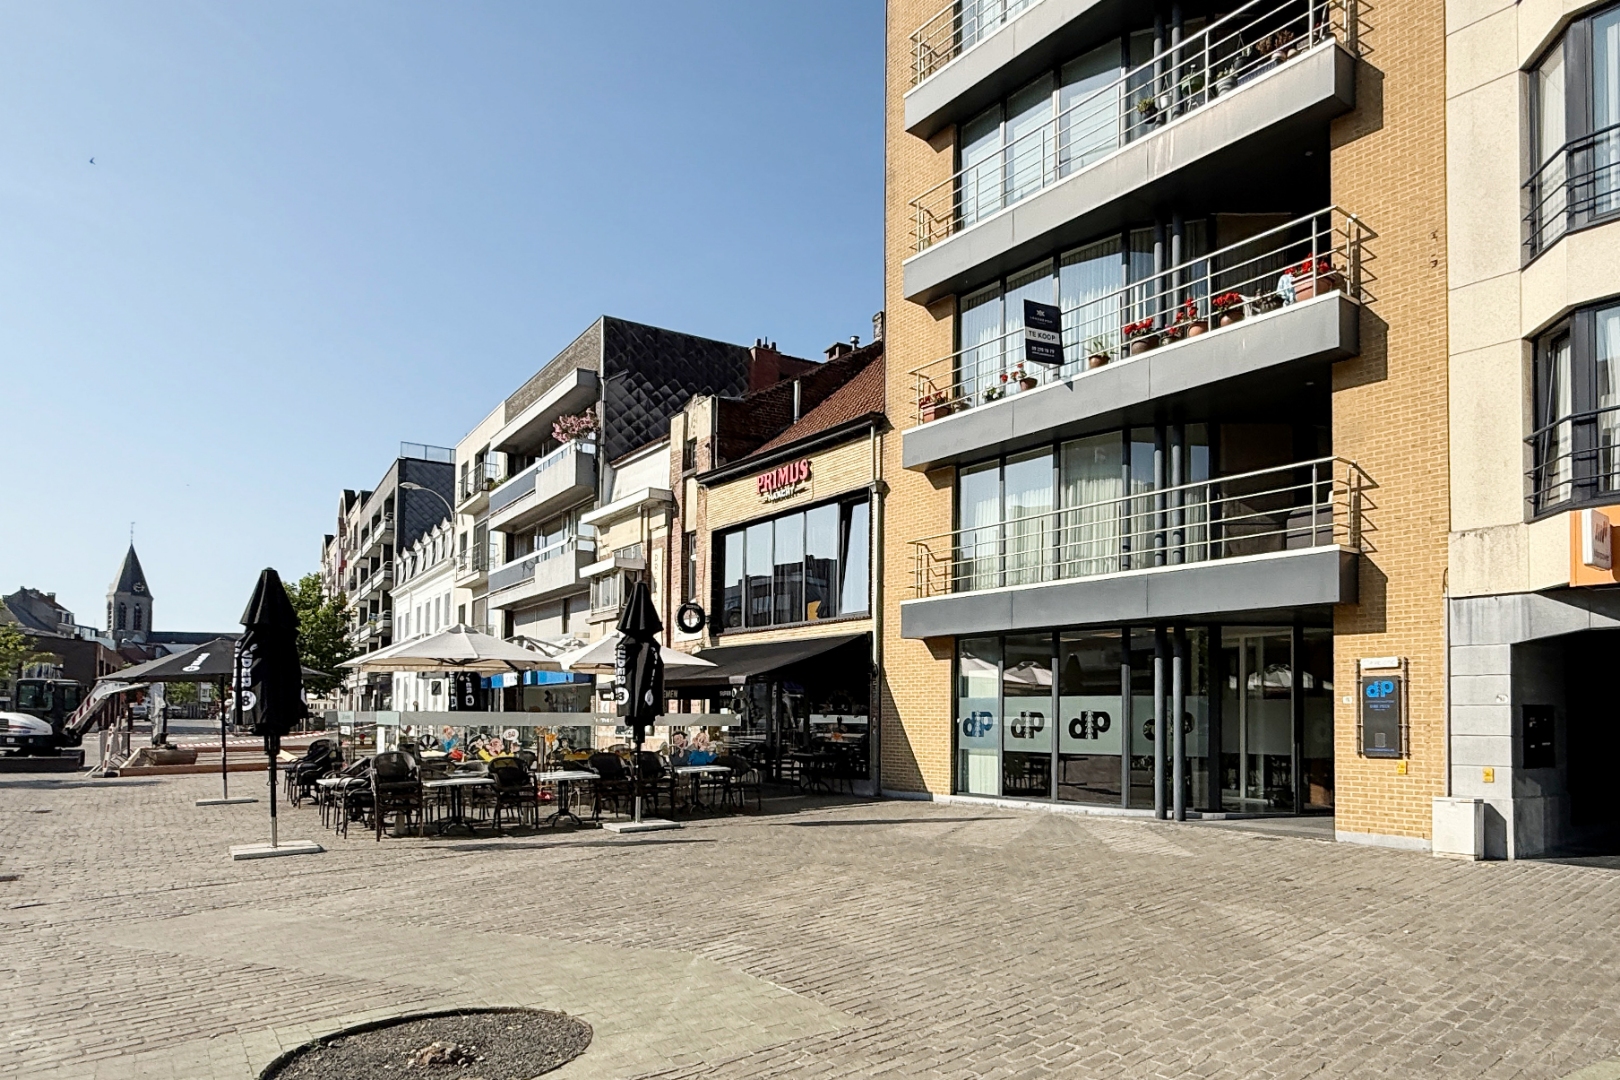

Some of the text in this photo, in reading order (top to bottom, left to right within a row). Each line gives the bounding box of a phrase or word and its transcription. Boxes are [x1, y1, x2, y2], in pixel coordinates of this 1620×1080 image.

[1028, 330, 1056, 341] TE KOOP
[756, 458, 809, 494] PRIMUS
